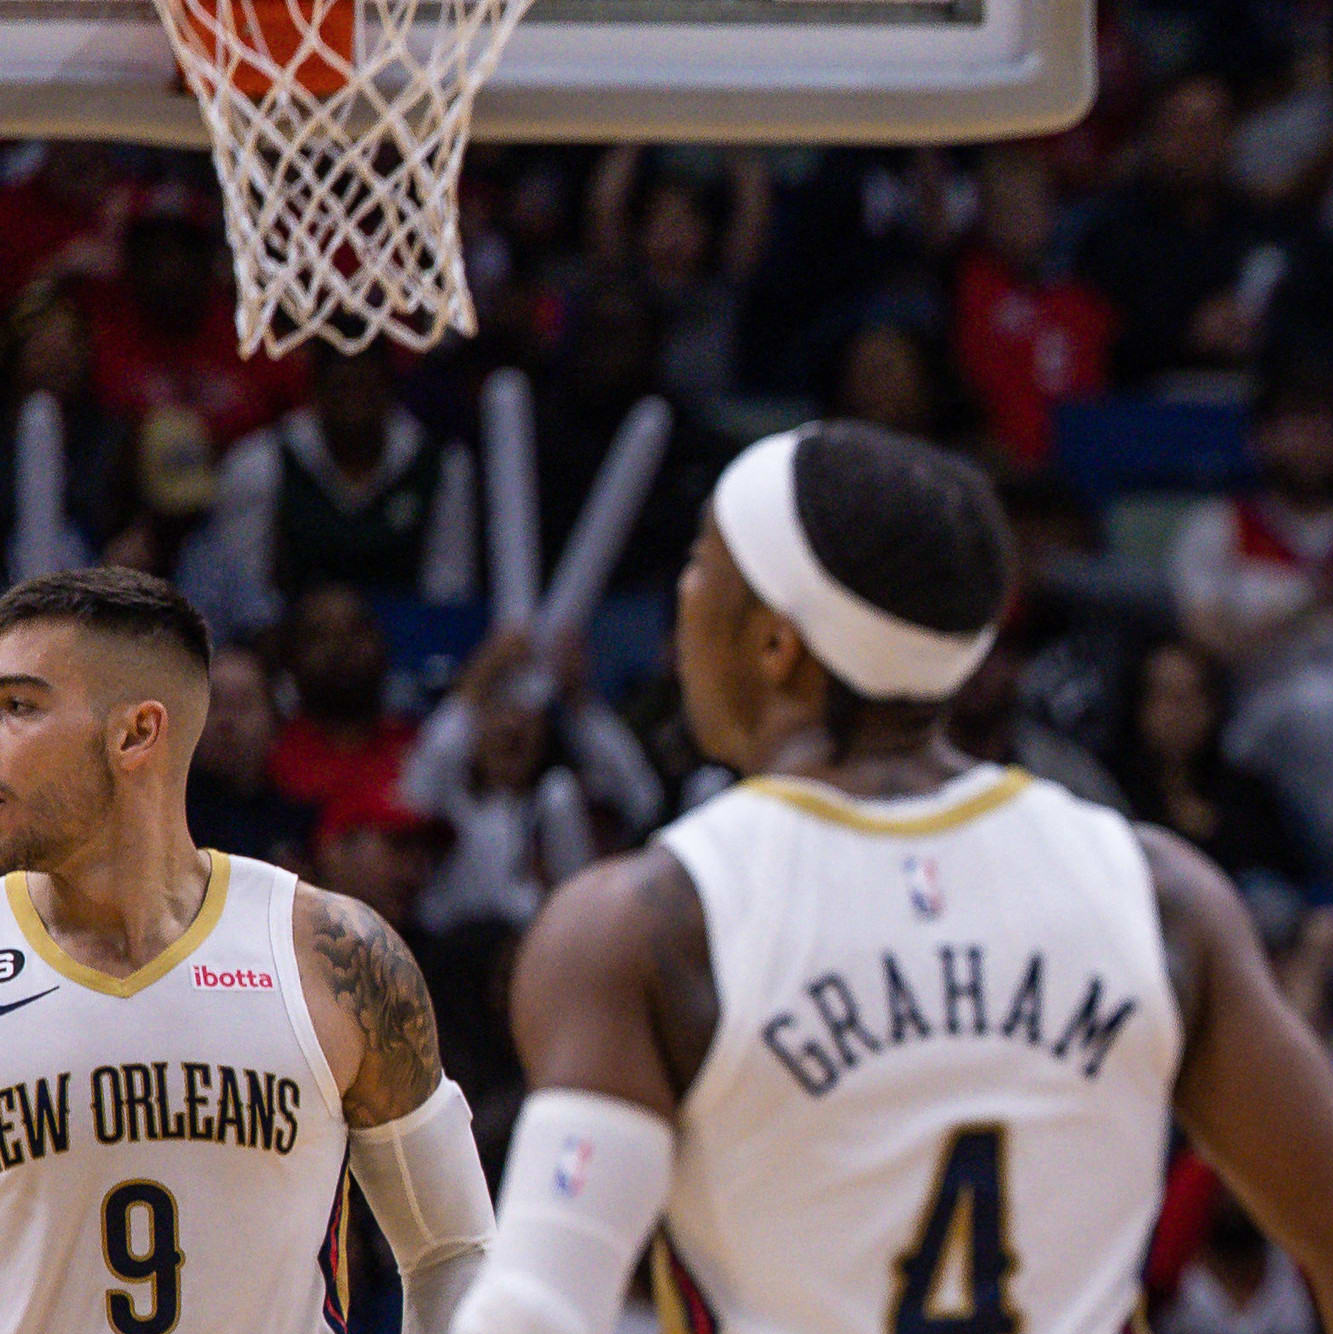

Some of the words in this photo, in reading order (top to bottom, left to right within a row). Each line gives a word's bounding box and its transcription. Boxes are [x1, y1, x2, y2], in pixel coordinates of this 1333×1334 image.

[194, 965, 273, 990] ibotta
[761, 944, 1138, 1099] GRAHAM
[0, 1071, 72, 1173] EW
[90, 1062, 300, 1155] ORLEANS
